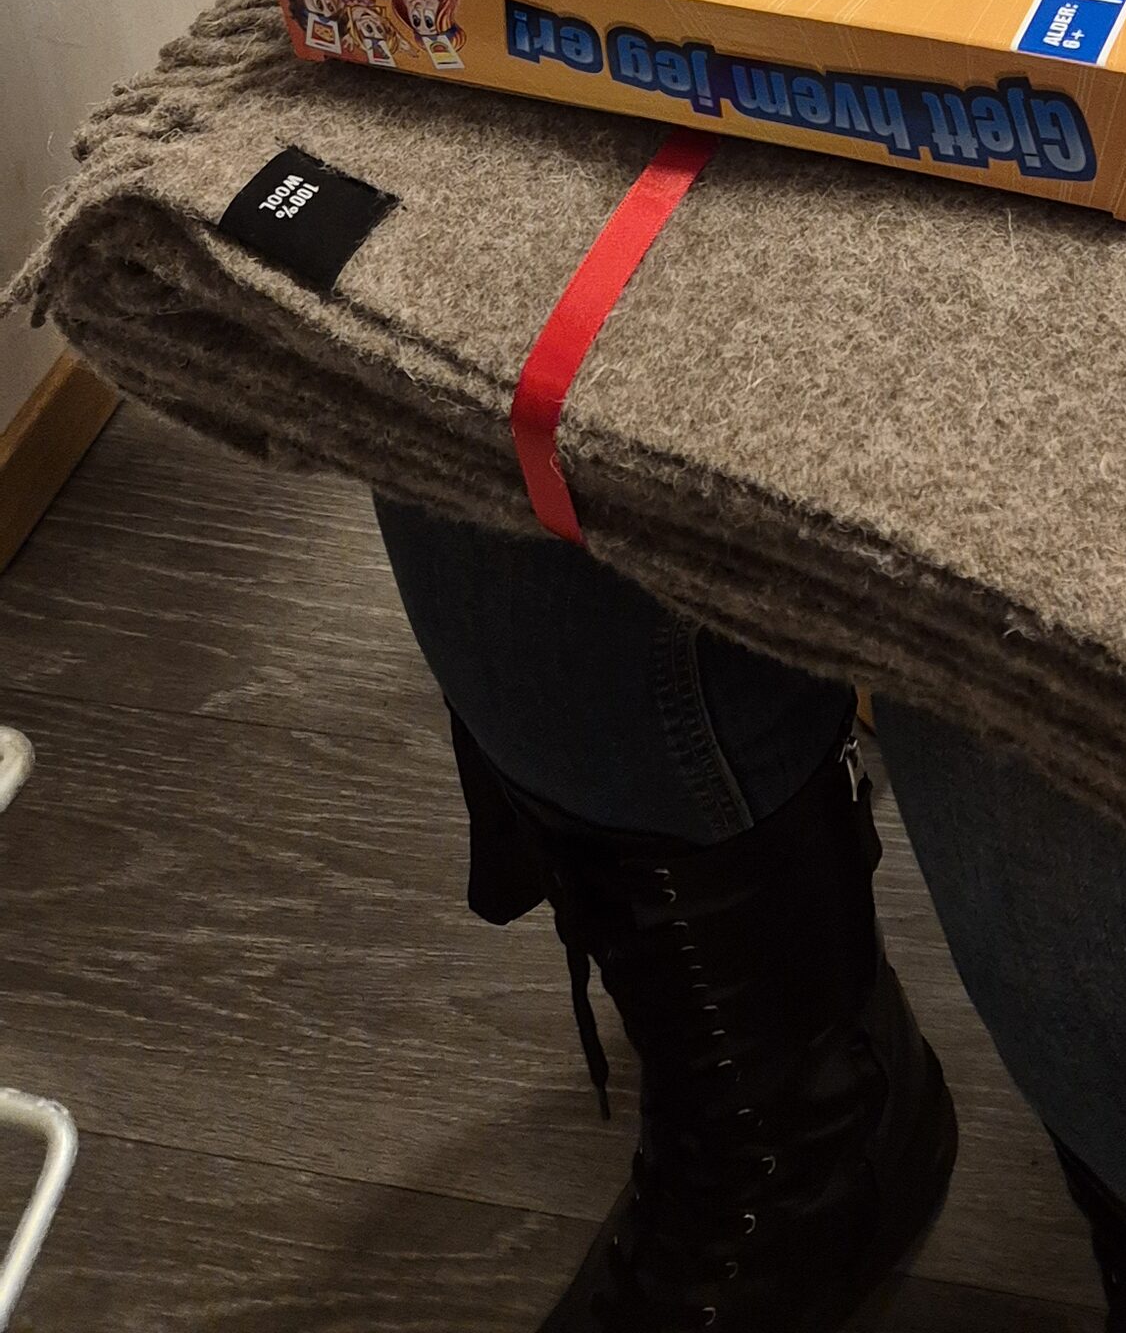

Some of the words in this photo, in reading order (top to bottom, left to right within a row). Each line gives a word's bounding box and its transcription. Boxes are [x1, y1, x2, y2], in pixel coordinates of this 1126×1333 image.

[513, 9, 596, 65] er!
[1042, 2, 1079, 46] ALDER:
[1061, 28, 1085, 49] 6+
[616, 33, 716, 109] jeg
[730, 64, 913, 151] hvem
[921, 87, 1088, 174] Gjett
[258, 174, 305, 211] WOOL
[275, 182, 320, 219] 100%
